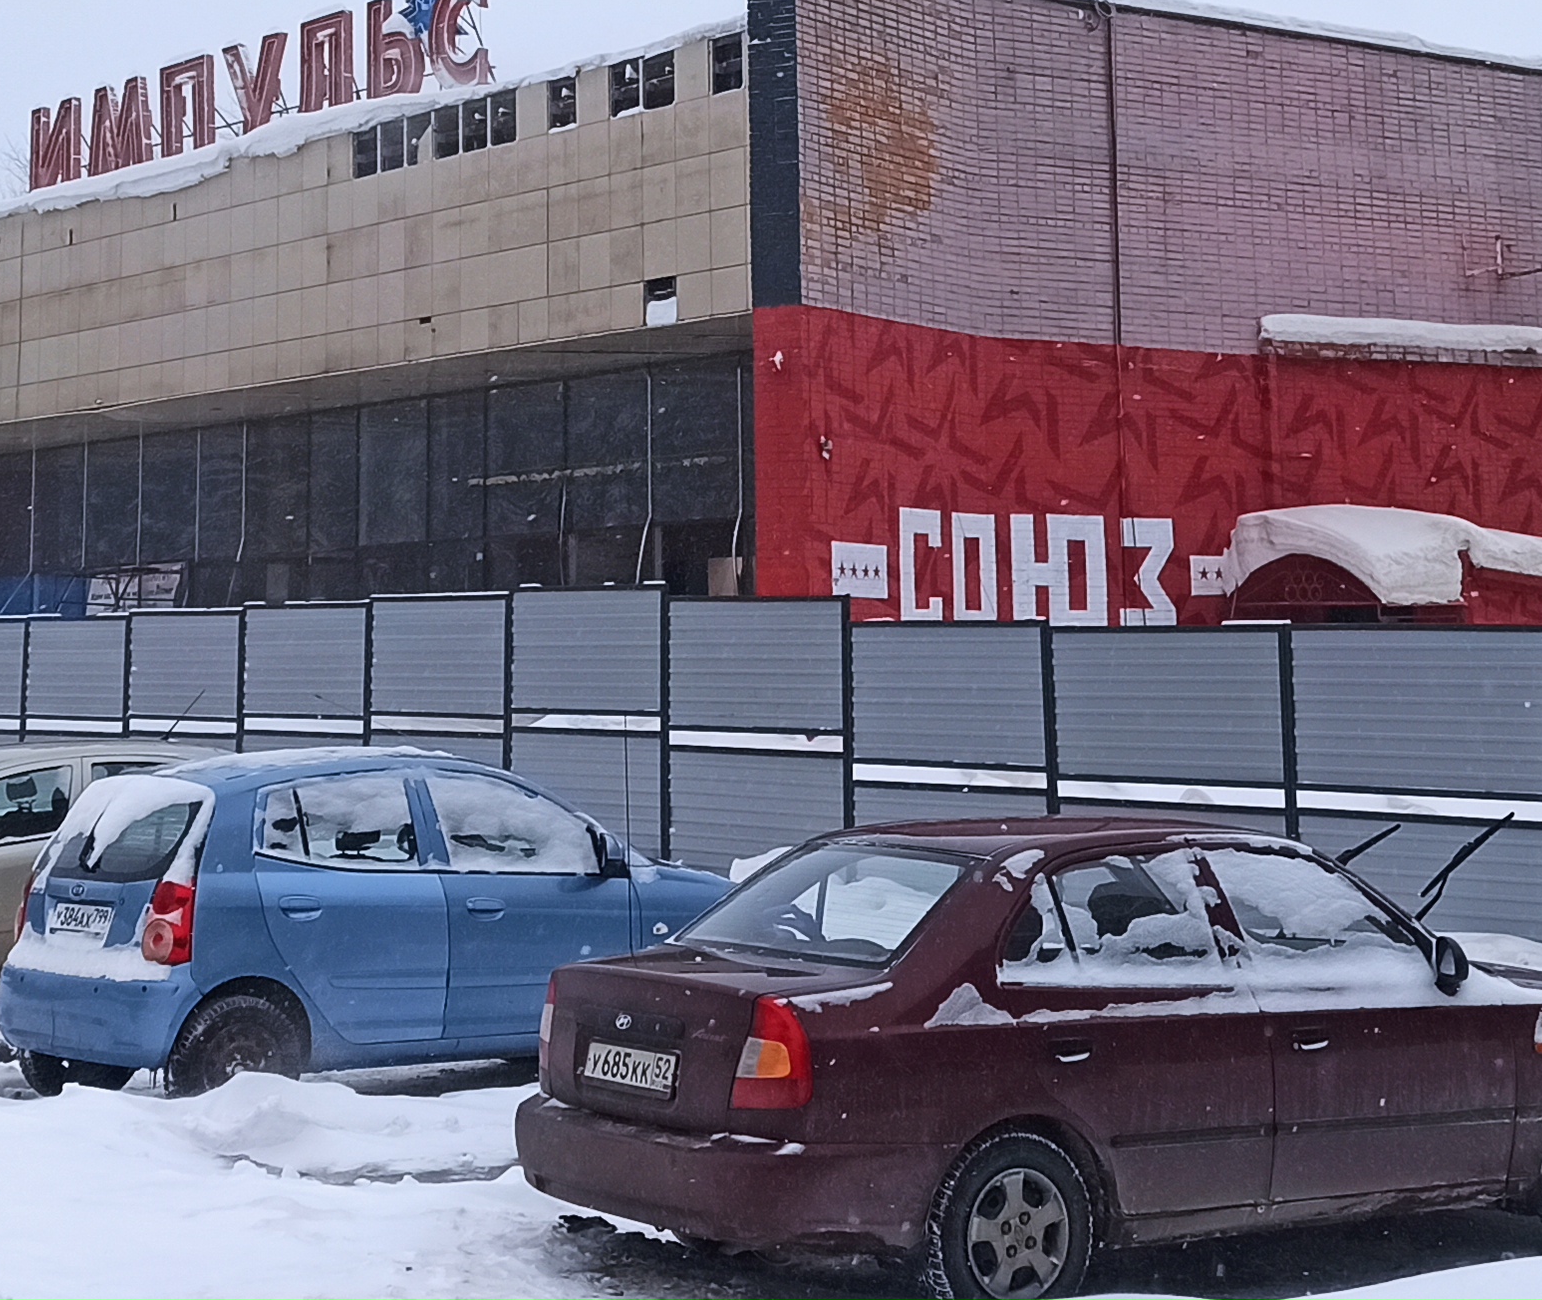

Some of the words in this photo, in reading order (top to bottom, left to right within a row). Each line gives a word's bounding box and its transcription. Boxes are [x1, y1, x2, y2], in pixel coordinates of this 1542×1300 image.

[898, 506, 1178, 628] СОЮЗ
[591, 1048, 651, 1085] У685КК
[654, 1056, 671, 1081] 52
